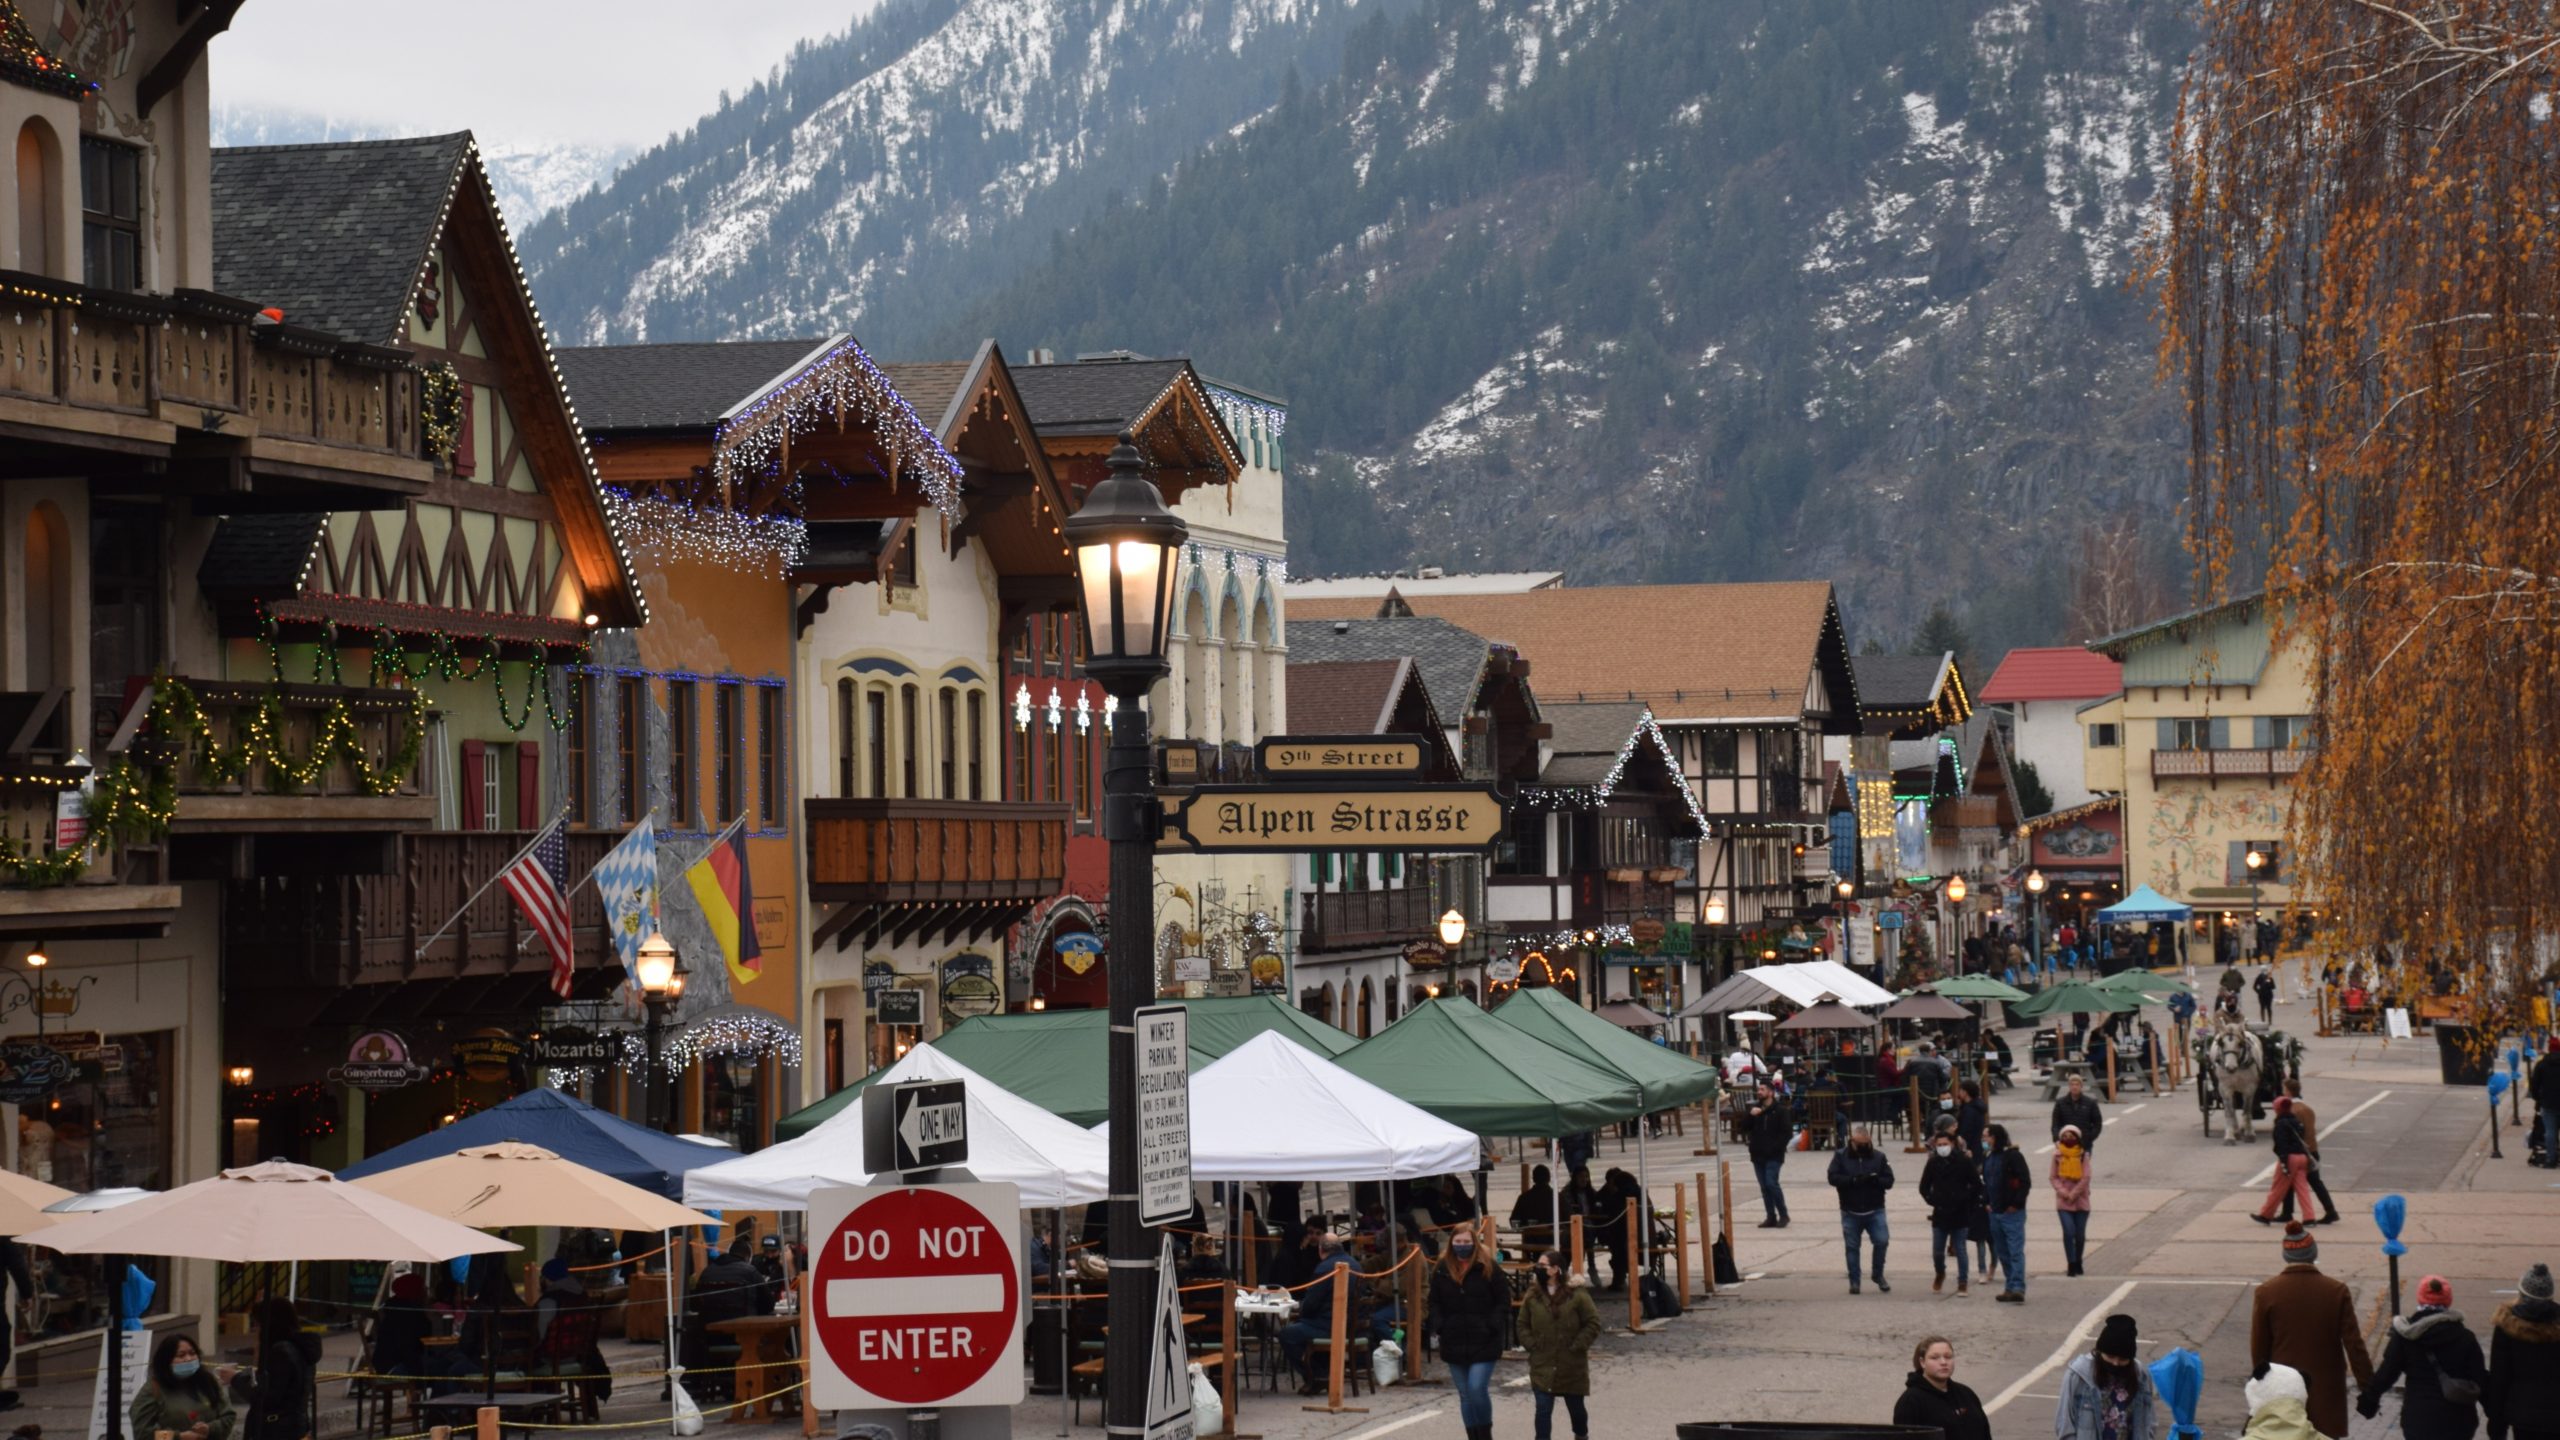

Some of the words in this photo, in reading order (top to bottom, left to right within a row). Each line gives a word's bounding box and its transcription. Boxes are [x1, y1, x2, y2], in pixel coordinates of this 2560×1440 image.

[1280, 749, 1311, 766] 9th
[1321, 749, 1405, 765] Street
[1218, 801, 1316, 839] Alpen
[1330, 801, 1470, 834] Strasse
[1150, 1022, 1175, 1042] WINTER
[534, 1040, 605, 1060] Mozart's
[1148, 1046, 1177, 1068] PARKING
[343, 1067, 406, 1079] Gingerbread
[1140, 1070, 1186, 1095] REGULATIONS
[1160, 1097, 1167, 1110] TO
[1179, 1094, 1184, 1107] 15
[919, 1109, 939, 1142] ONE
[943, 1106, 962, 1138] WAY
[1144, 1117, 1153, 1131] NO
[1156, 1113, 1184, 1129] PARKING
[1143, 1136, 1156, 1149] ALL
[1159, 1130, 1187, 1146] STREETS
[1143, 1154, 1148, 1167] 3
[1150, 1152, 1160, 1166] AM
[1162, 1151, 1170, 1164] TO
[1172, 1150, 1177, 1162] 7
[1178, 1148, 1187, 1161] AM
[843, 1229, 890, 1262] DO
[919, 1226, 985, 1259] NOT
[859, 1326, 973, 1361] ENTER
